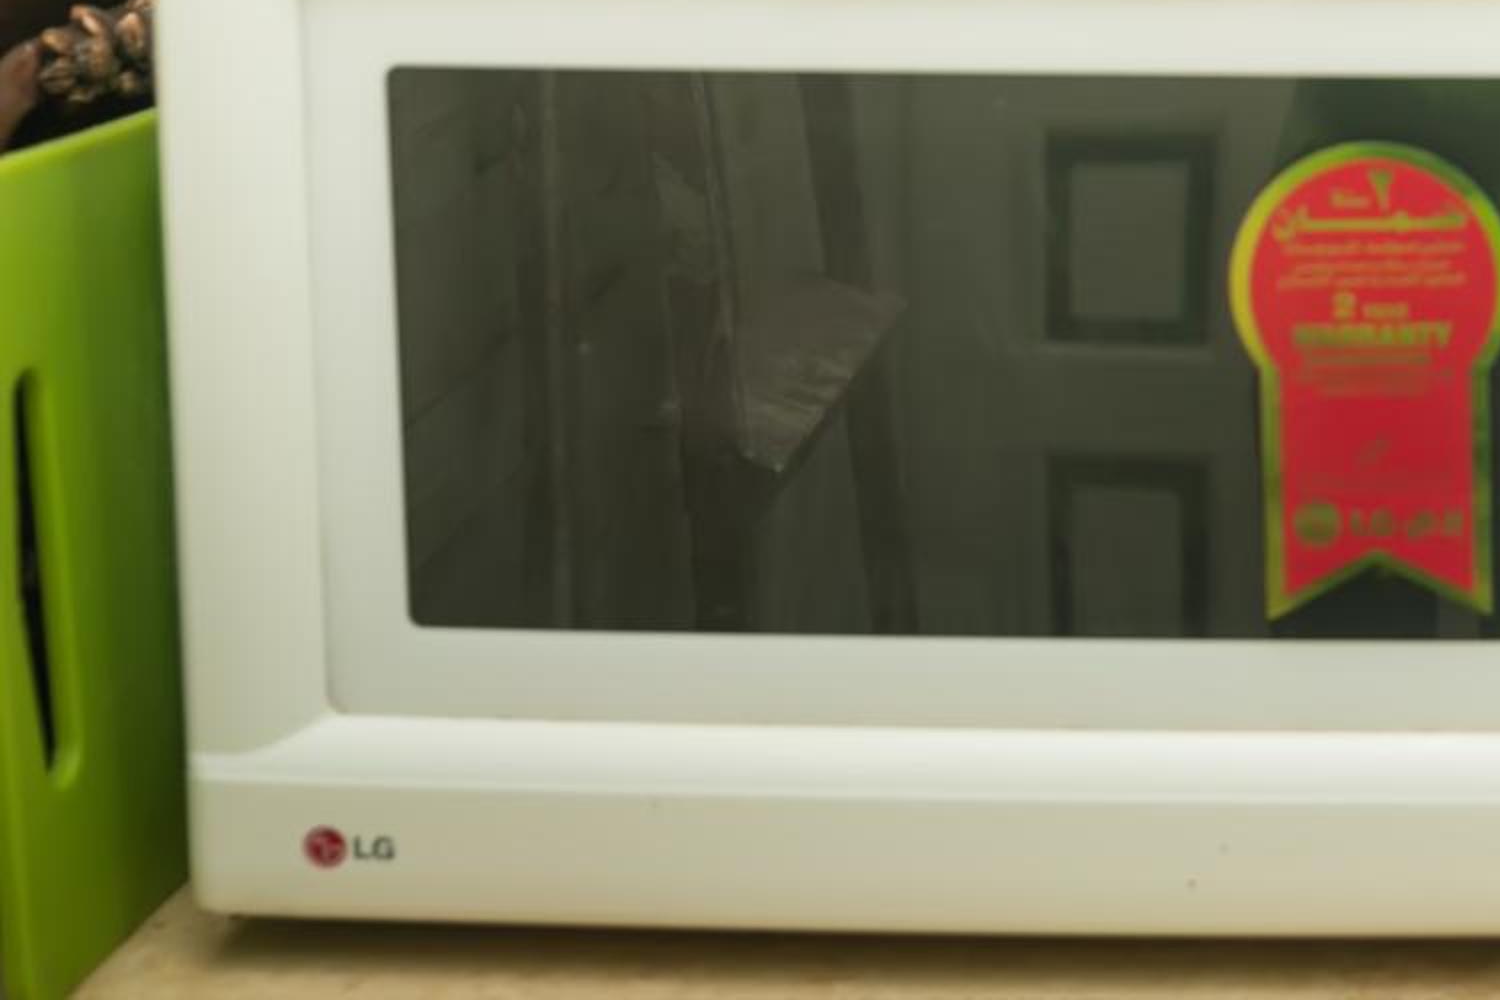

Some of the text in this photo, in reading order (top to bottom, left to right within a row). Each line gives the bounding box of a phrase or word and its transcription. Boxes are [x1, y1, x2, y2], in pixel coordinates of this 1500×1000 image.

[1332, 293, 1357, 319] 2
[1293, 321, 1452, 346] WARRANTY
[352, 834, 396, 861] LG
